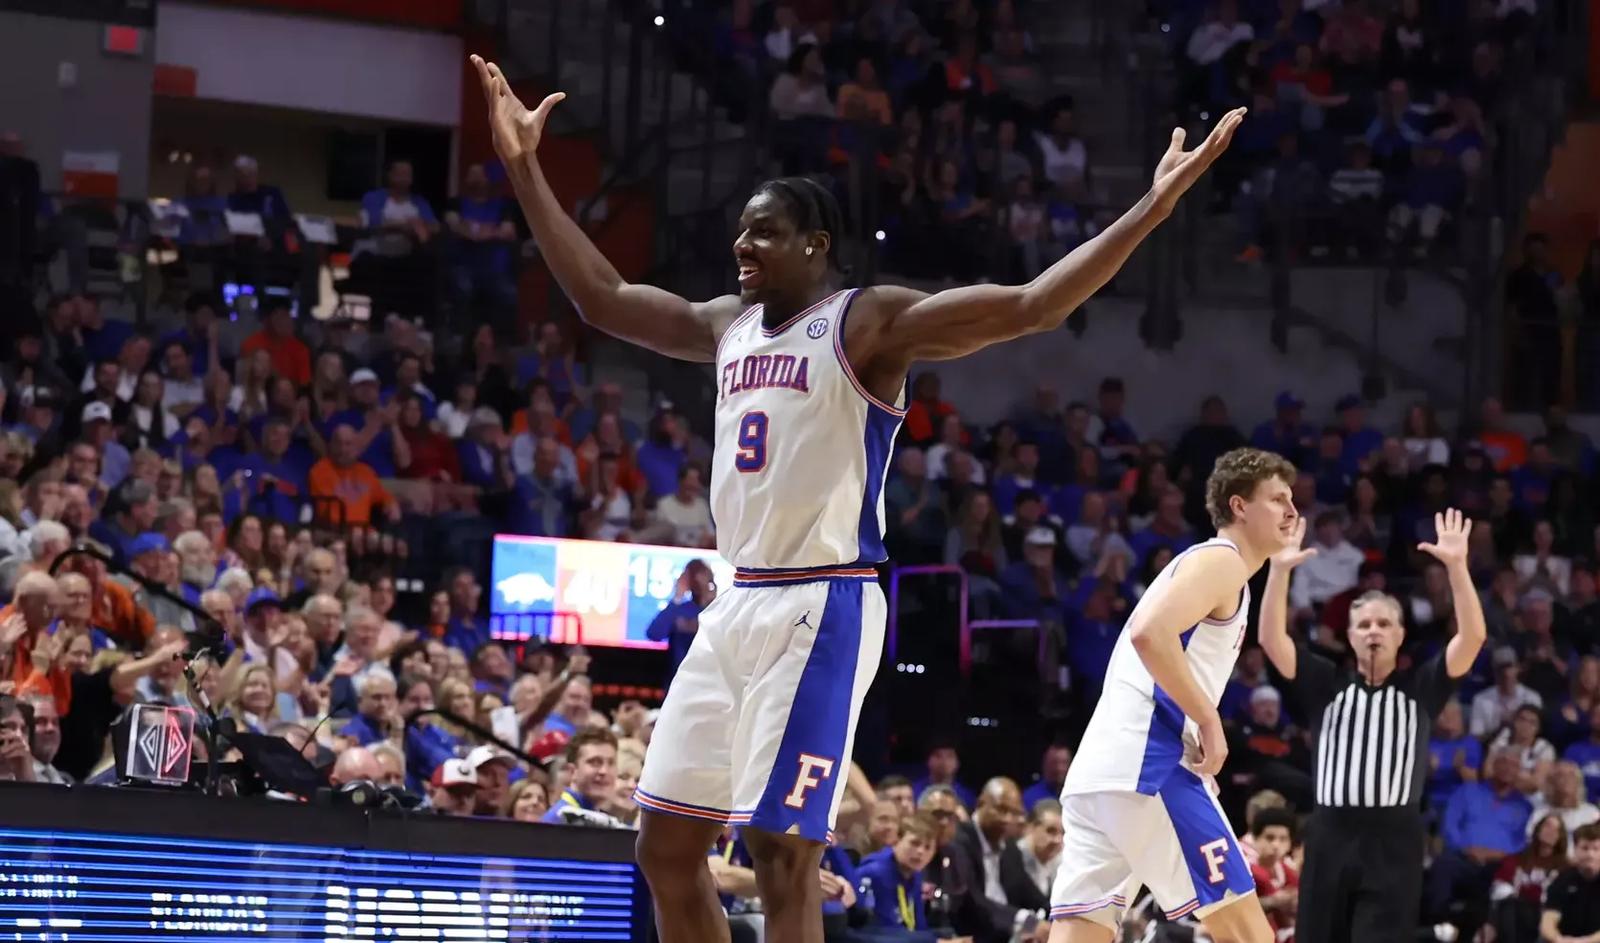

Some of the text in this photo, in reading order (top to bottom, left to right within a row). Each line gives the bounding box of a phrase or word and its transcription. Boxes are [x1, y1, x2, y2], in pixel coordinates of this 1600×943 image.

[720, 353, 810, 401] FLORIDA
[734, 410, 770, 474] 9
[783, 752, 836, 809] F
[1199, 836, 1230, 885] F
